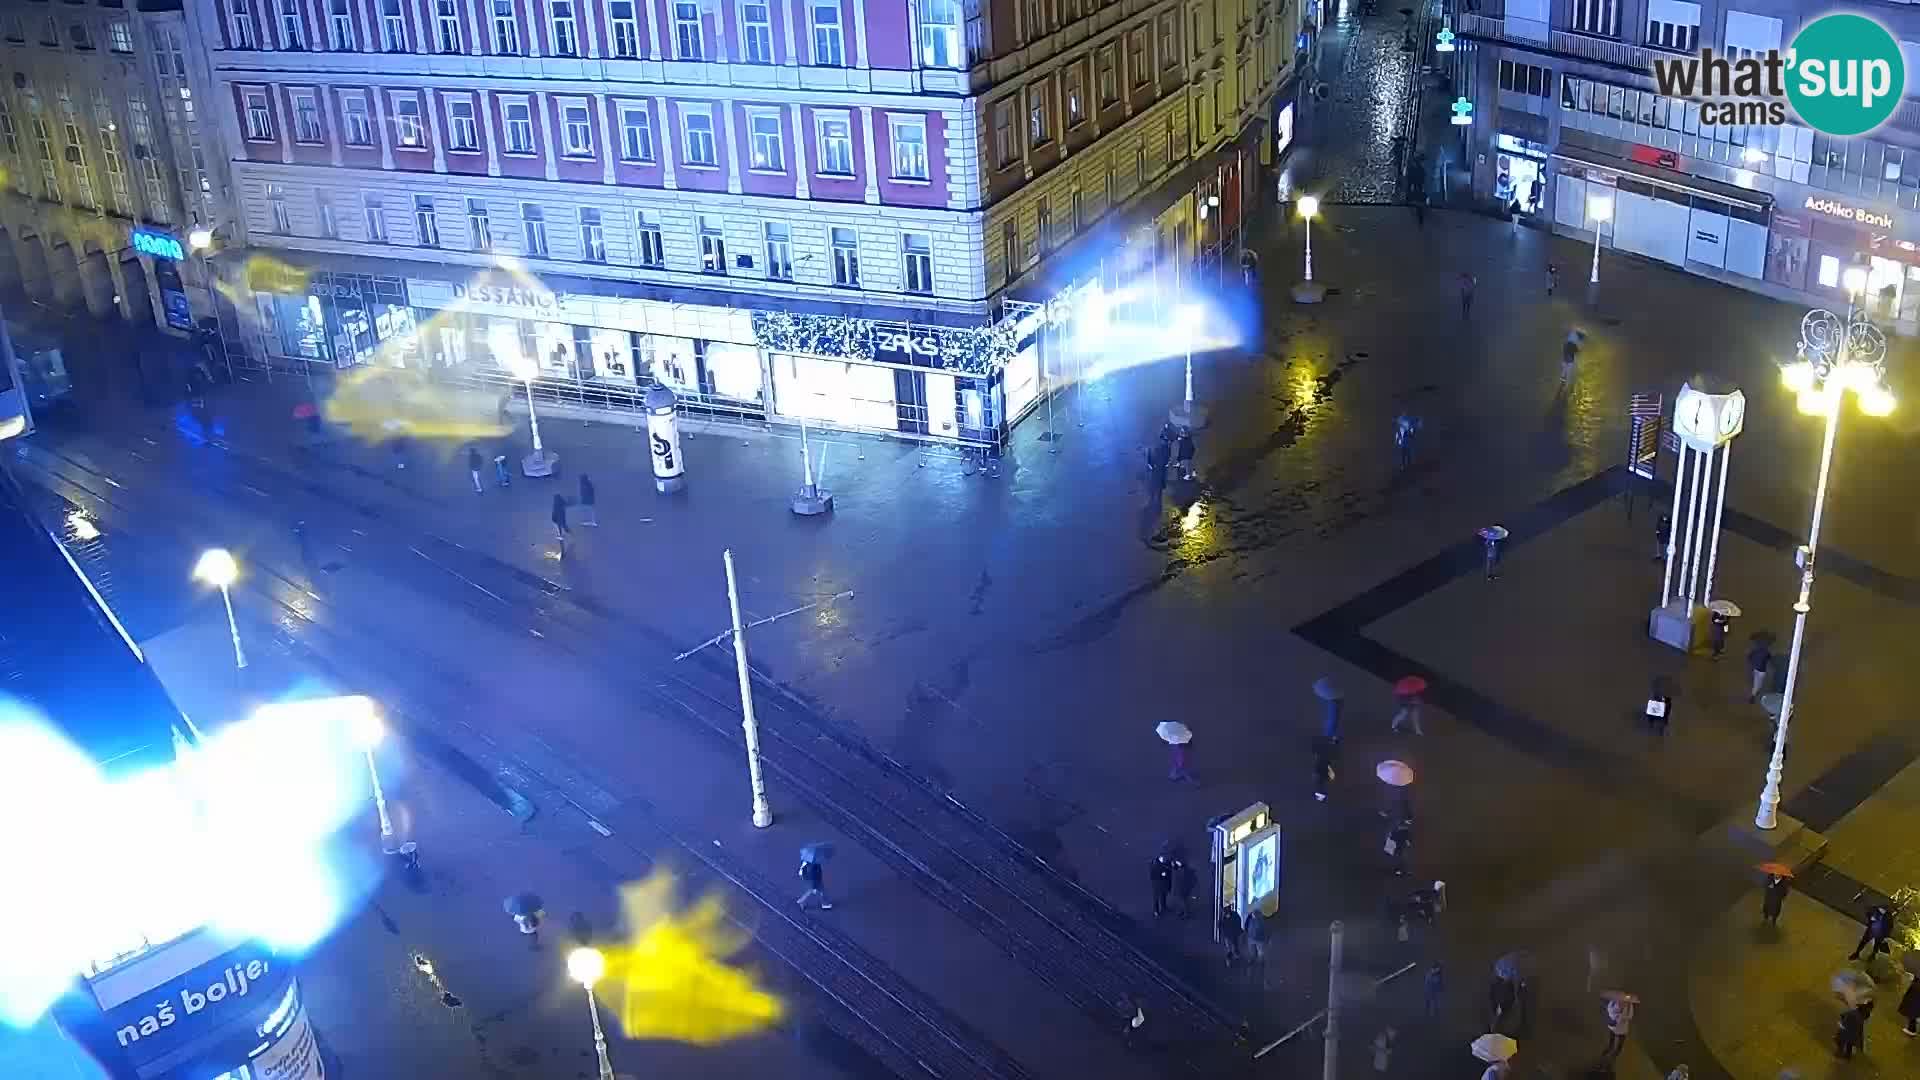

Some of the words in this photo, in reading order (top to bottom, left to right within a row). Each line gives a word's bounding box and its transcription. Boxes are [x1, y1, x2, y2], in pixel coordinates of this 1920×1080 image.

[1805, 196, 1853, 219] Addiko
[1855, 208, 1893, 229] Bank
[877, 331, 939, 356] ZAKS
[116, 1000, 176, 1047] naš
